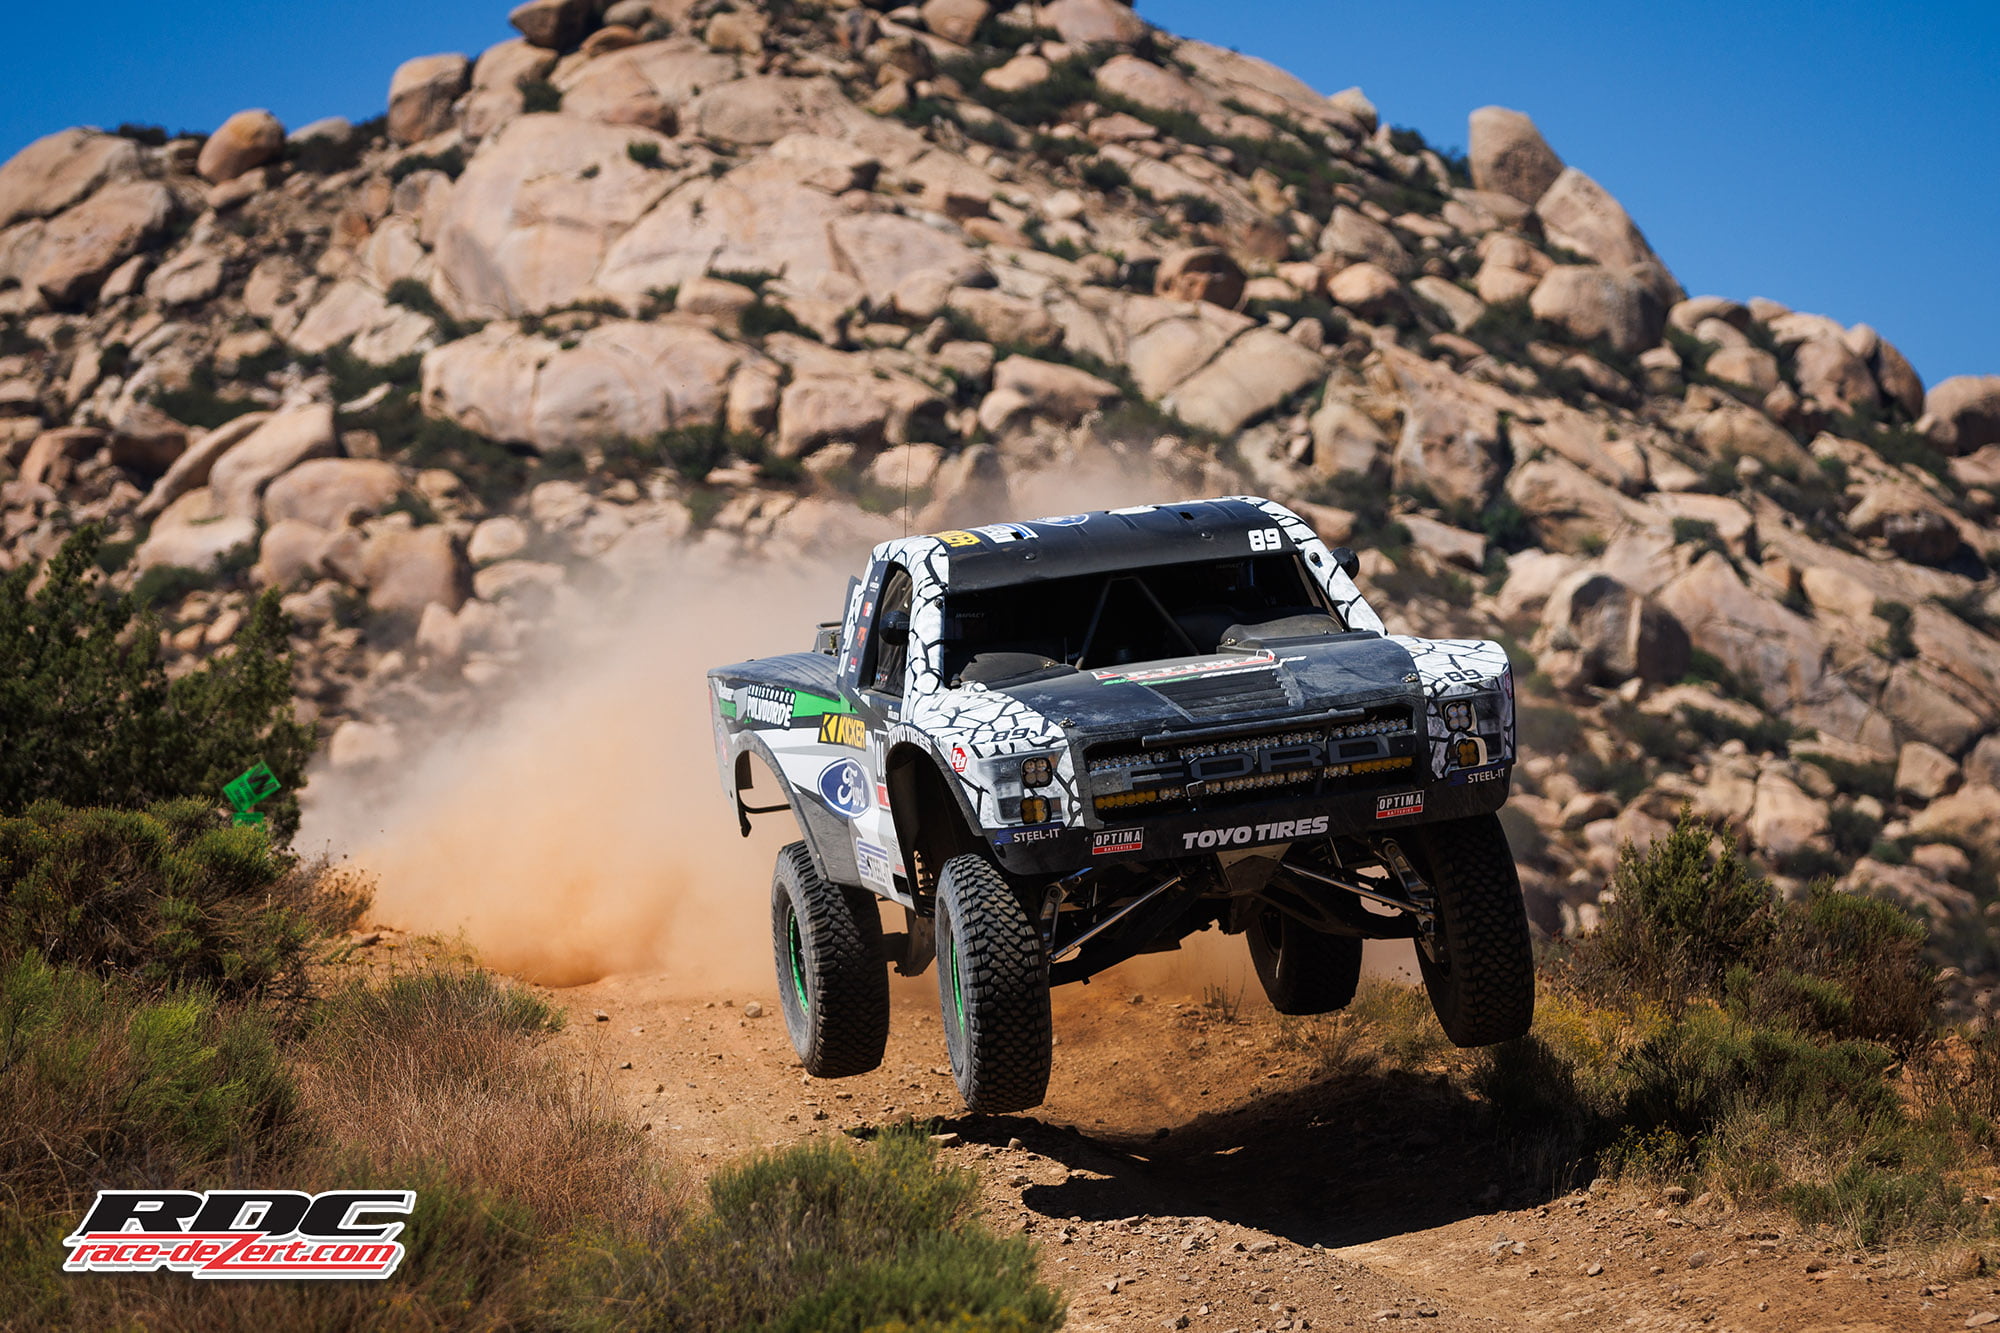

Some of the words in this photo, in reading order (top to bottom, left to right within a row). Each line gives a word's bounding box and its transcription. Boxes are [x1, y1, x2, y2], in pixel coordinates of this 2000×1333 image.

[1248, 527, 1282, 552] 89
[1445, 669, 1484, 683] 89
[748, 683, 796, 704] CHRISTOPHER
[747, 695, 794, 727] POLVOORDE
[837, 715, 867, 750] KICKER
[888, 725, 904, 749] TOYO
[904, 726, 933, 755] TIRES
[990, 727, 1031, 743] 89
[1119, 736, 1391, 793] FORD
[1468, 767, 1505, 784] STEEL-IT
[836, 766, 866, 808] Ford
[1379, 792, 1422, 810] OPTIMA
[1013, 828, 1060, 843] STEEL-IT
[1095, 829, 1142, 846] OPTIMA
[1182, 825, 1253, 849] TOYO
[1254, 815, 1329, 841] TIRES
